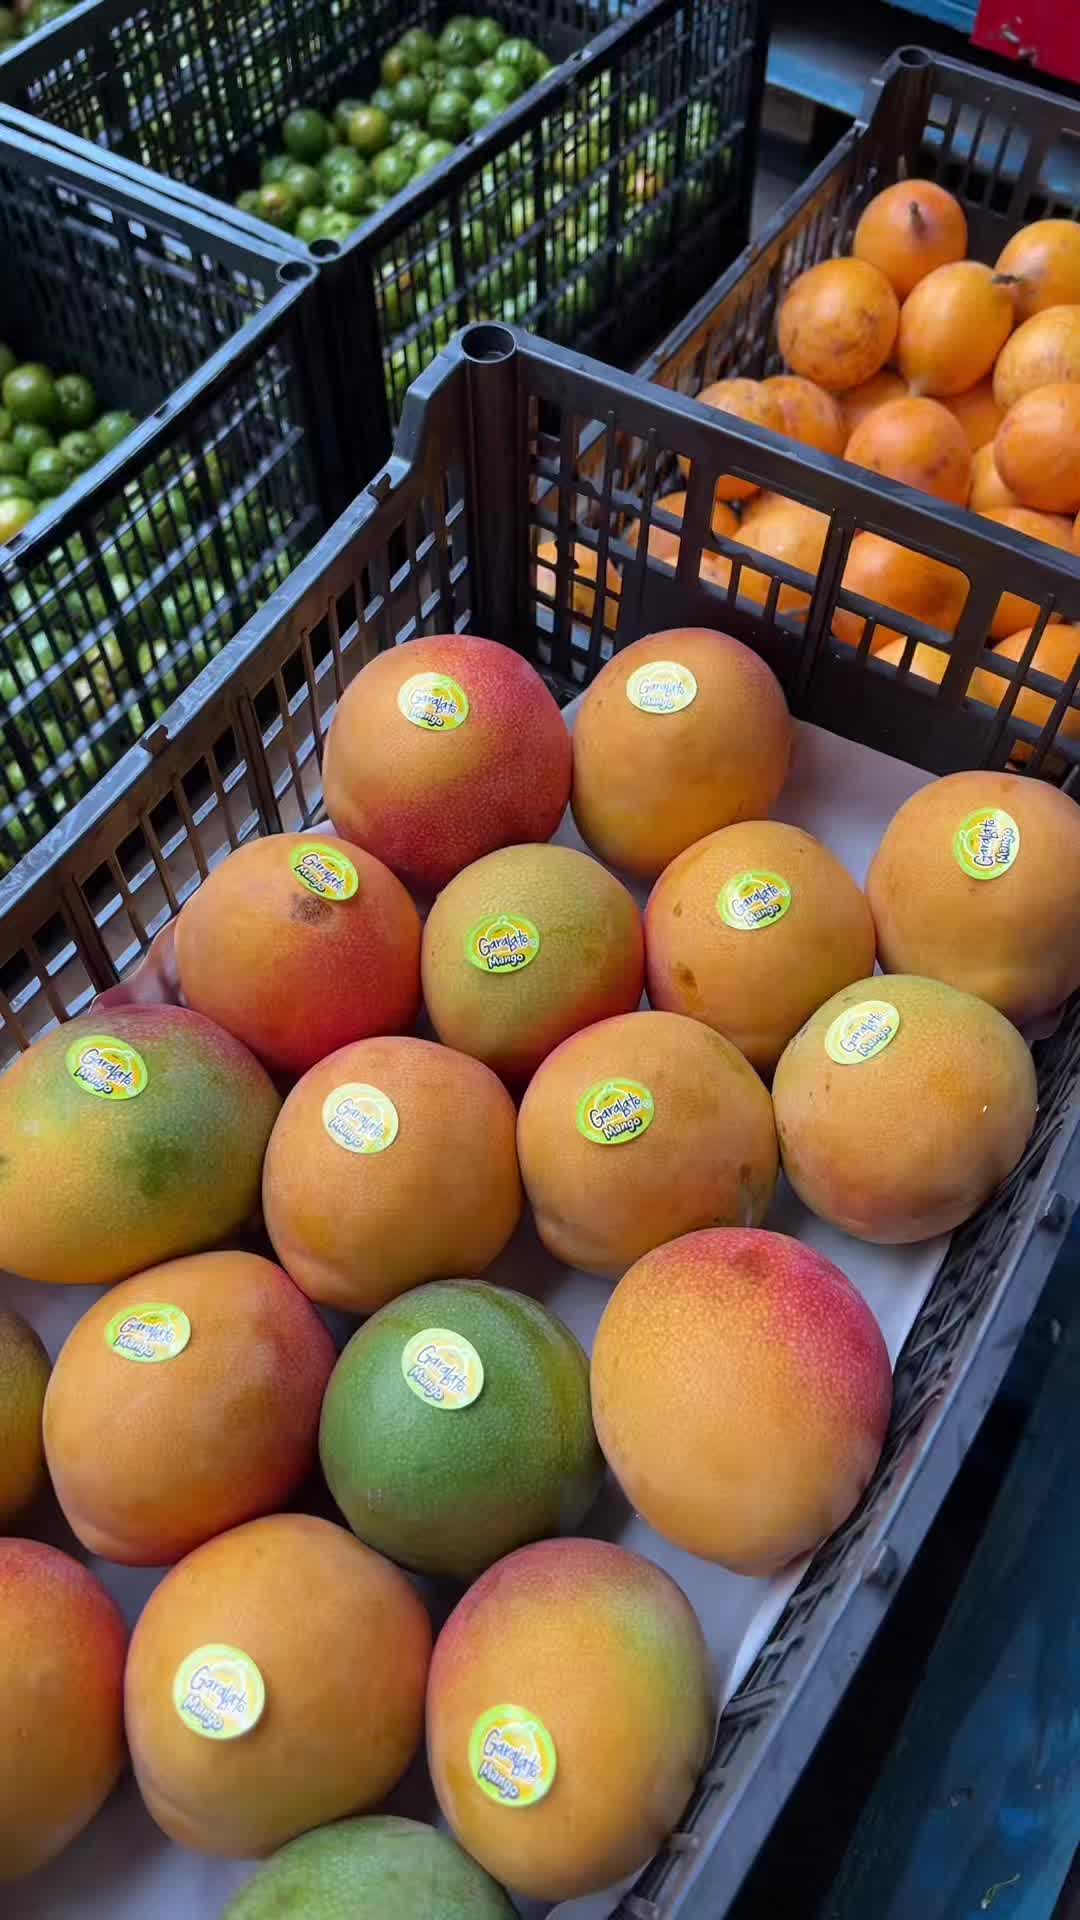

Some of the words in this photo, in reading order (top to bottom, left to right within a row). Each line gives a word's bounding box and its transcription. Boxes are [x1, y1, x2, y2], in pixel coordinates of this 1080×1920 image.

[996, 828, 1013, 864] Mango
[744, 904, 781, 926] Mango
[487, 953, 525, 969] Mango
[74, 1068, 113, 1094] Mango
[602, 1117, 642, 1140] Mango
[114, 1335, 155, 1357] Mango
[408, 1365, 444, 1401] Mango
[478, 1760, 519, 1798] Mango
